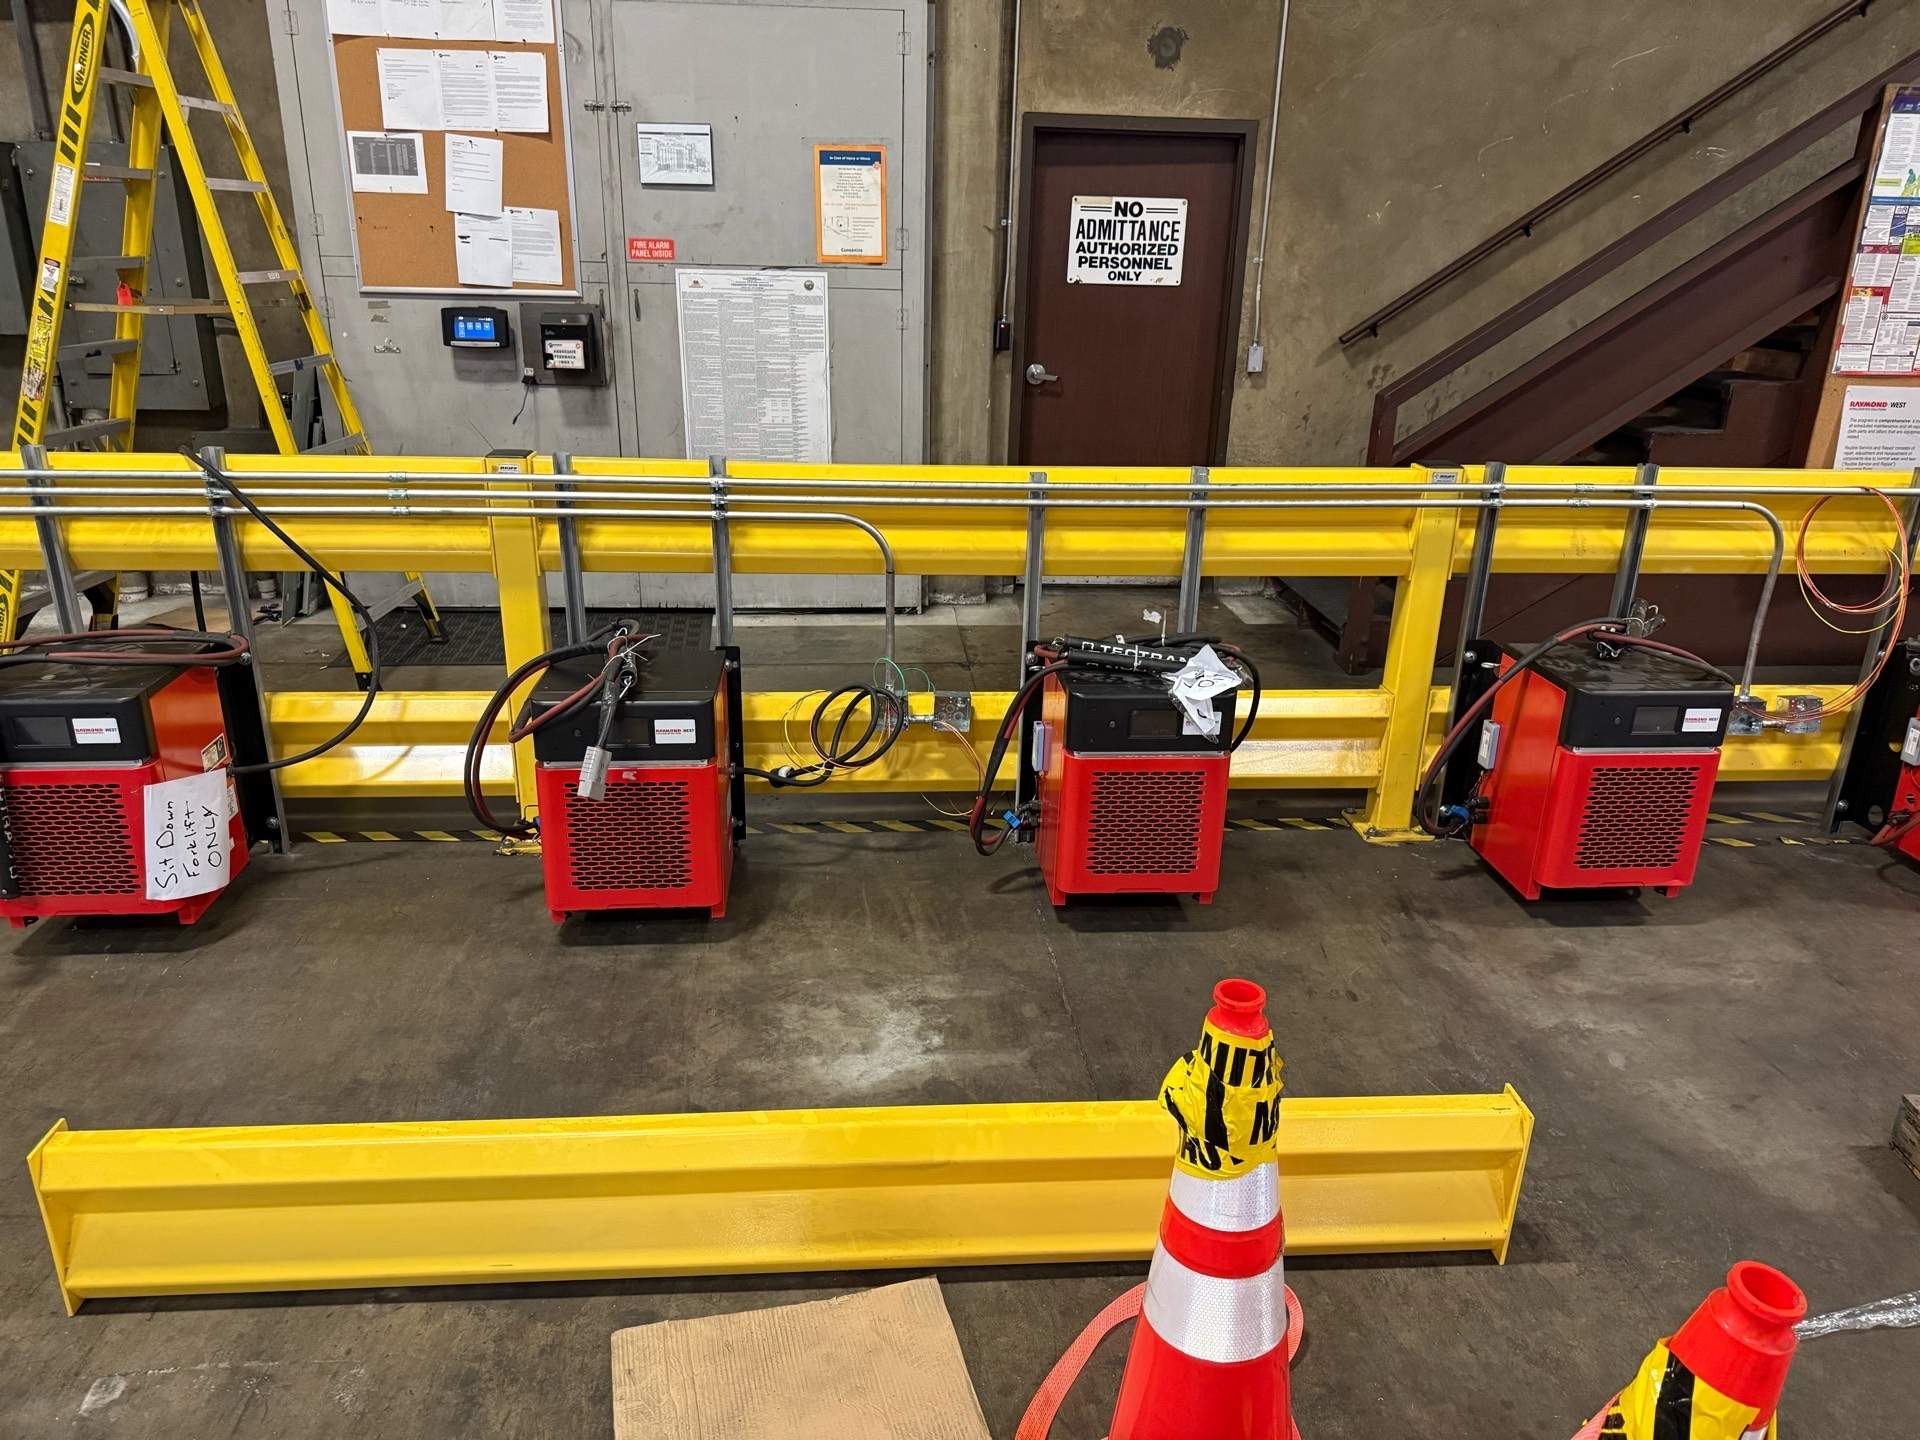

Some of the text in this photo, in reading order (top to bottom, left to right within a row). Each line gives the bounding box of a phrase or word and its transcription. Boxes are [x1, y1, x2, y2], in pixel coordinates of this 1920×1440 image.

[75, 28, 92, 86] WERNER
[1114, 201, 1144, 217] NO
[1076, 219, 1180, 242] ADMITTANCE
[633, 240, 670, 250] FIRE ALARM
[1075, 242, 1179, 256] AUTHORIZED
[631, 248, 673, 258] PANEL INSIDE
[1078, 256, 1173, 270] PERSONNEL
[1108, 271, 1142, 281] ONLY
[201, 805, 222, 868] ONLY
[155, 801, 178, 889] Sit Down
